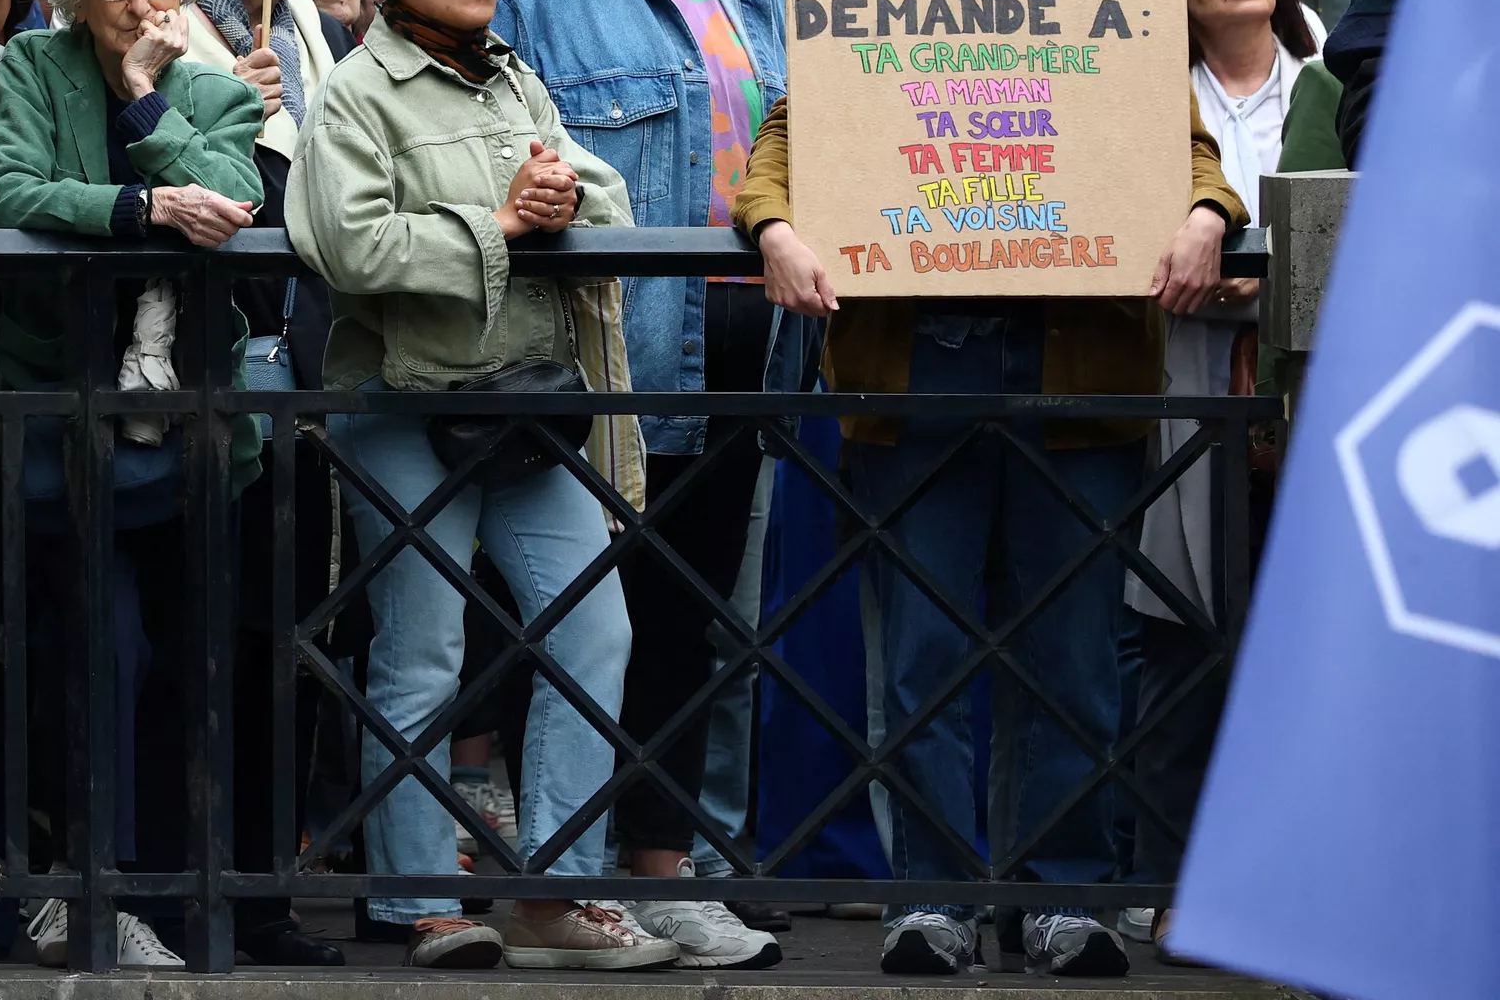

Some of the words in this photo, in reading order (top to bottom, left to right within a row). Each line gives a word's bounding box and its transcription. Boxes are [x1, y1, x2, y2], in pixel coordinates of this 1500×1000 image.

[852, 43, 903, 74] TA
[910, 41, 1101, 74] GRAND-MÈRE
[901, 82, 941, 106] TA
[945, 78, 1052, 105] MAMAN
[917, 111, 958, 138] TA
[967, 109, 1058, 139] SŒUR
[899, 144, 944, 174] TA
[949, 143, 1055, 173] FEMME
[917, 179, 961, 209] TA
[881, 207, 932, 236] TA
[840, 244, 893, 275] TA
[909, 234, 1118, 273] BOULANGÈRE
